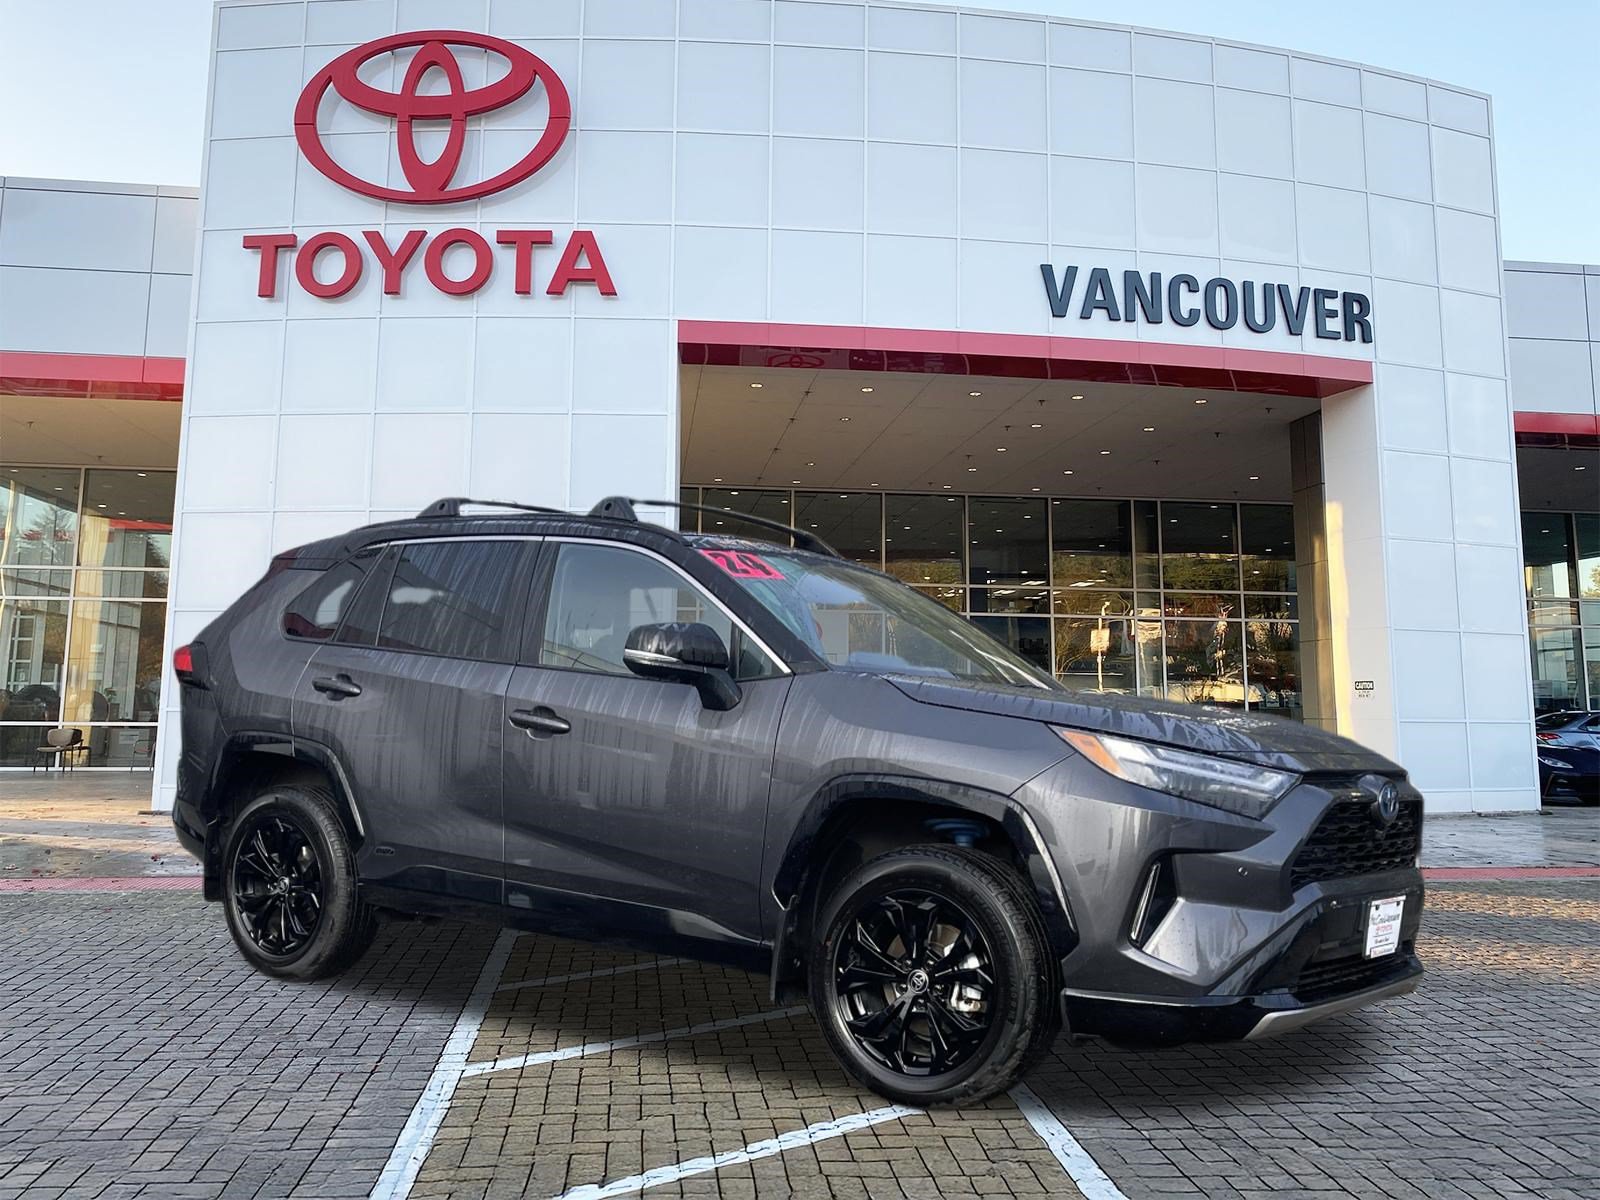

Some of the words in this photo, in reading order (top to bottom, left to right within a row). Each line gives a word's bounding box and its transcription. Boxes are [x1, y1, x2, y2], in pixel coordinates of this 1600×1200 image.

[242, 228, 618, 299] TOYOTA
[1040, 264, 1373, 343] VANCOUVER
[708, 552, 773, 576] 24
